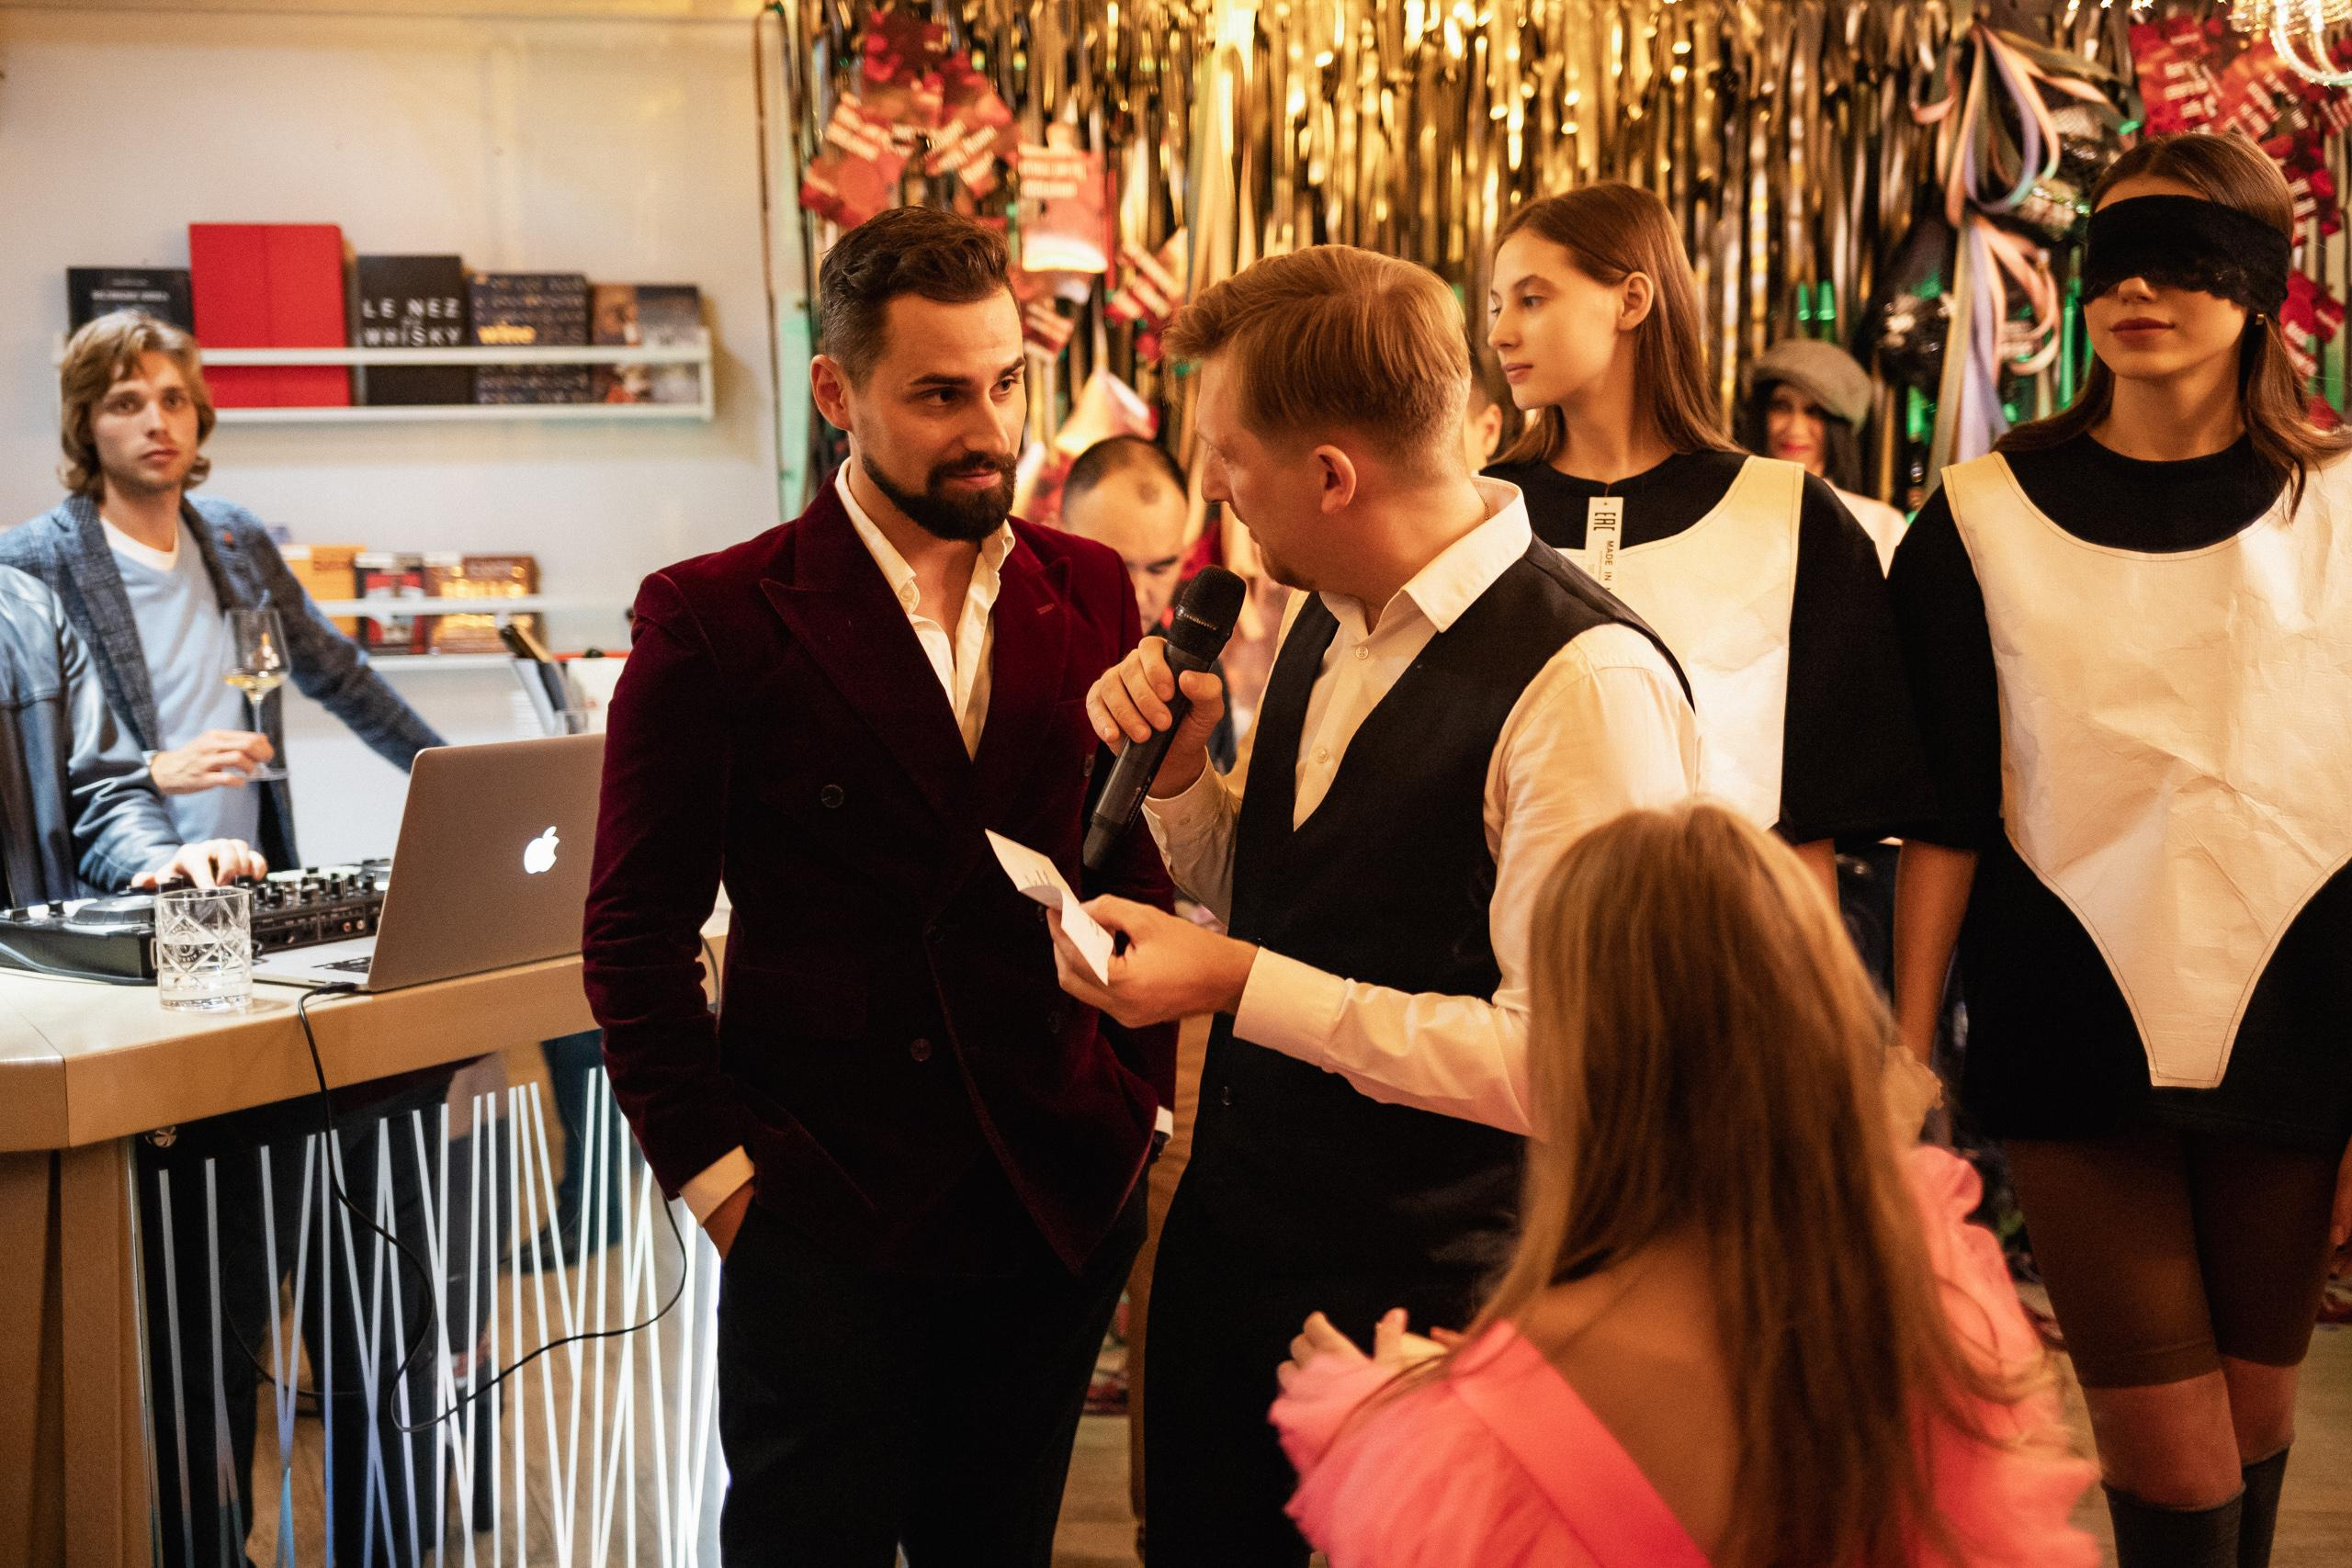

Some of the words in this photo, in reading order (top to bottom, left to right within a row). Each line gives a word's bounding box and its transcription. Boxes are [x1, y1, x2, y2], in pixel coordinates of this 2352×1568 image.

[363, 298, 396, 319] LE
[1605, 540, 1614, 566] MADE
[1604, 571, 1612, 581] IN
